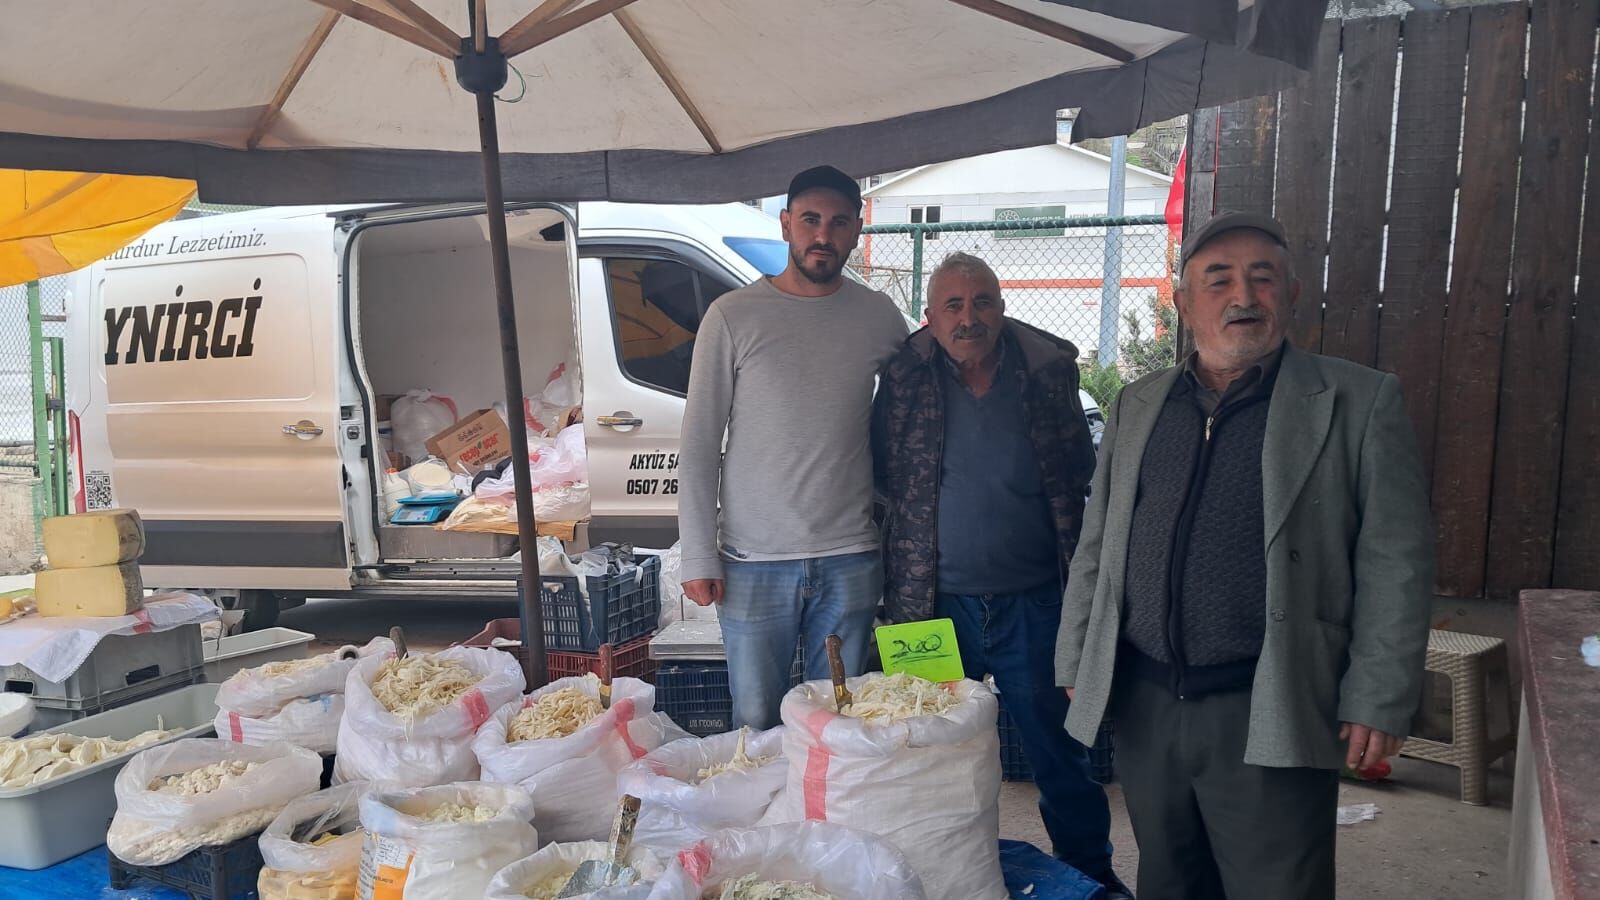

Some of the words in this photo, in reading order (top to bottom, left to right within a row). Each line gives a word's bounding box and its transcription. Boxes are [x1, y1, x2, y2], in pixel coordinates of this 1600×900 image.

[104, 239, 164, 261] urdur
[167, 228, 267, 255] Lezzetimiz.
[104, 277, 263, 366] YNİRCİ
[629, 449, 667, 470] AKYÜZ
[626, 479, 659, 495] 0507
[662, 479, 679, 495] 26
